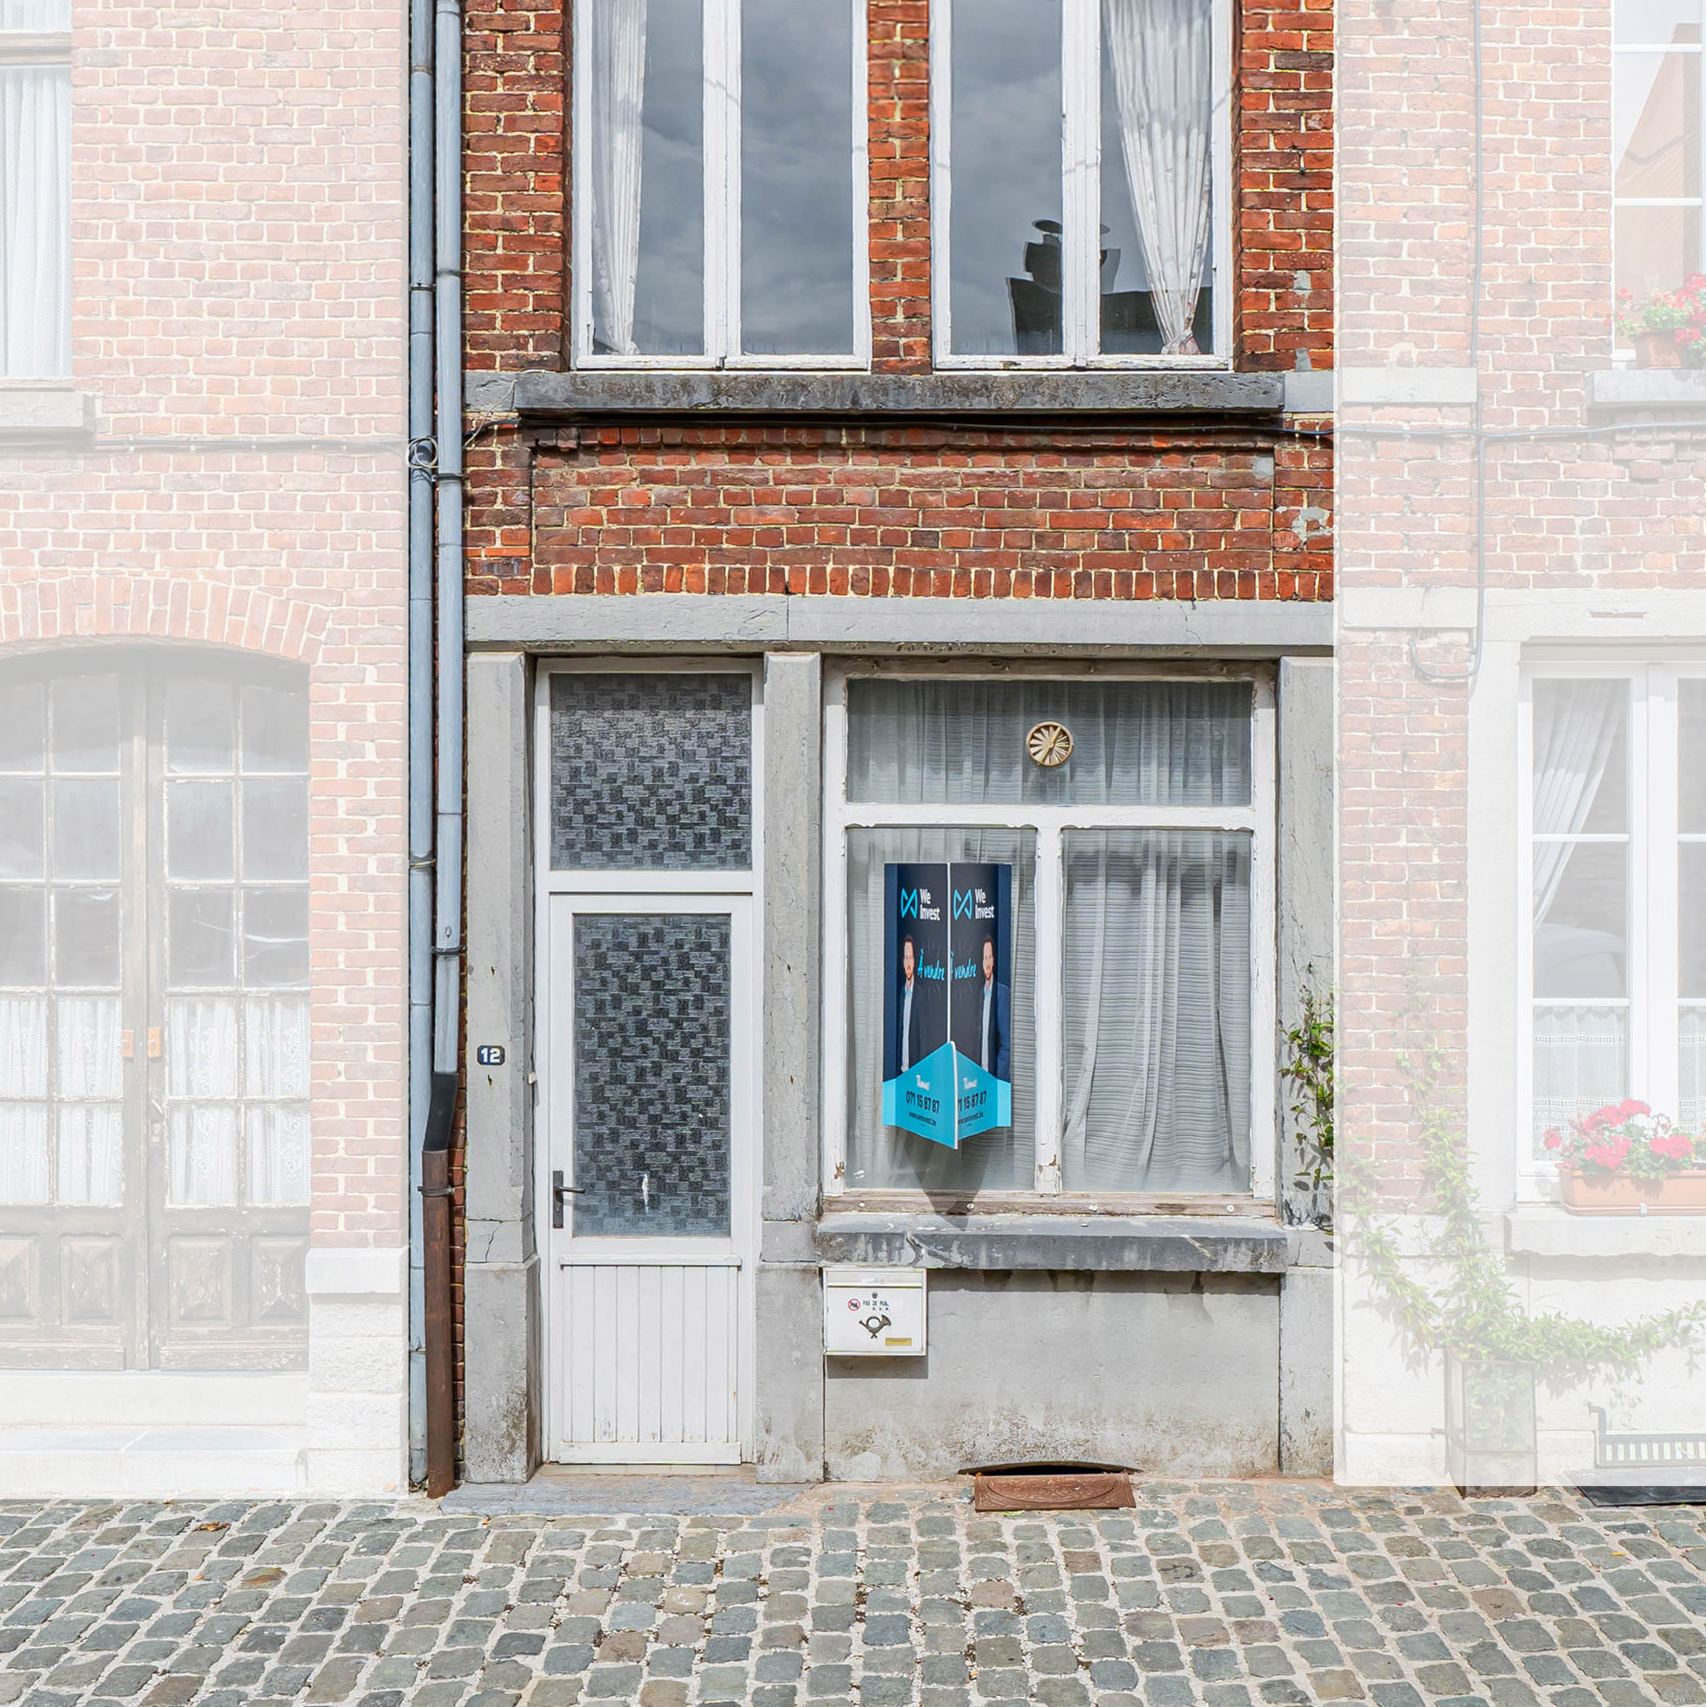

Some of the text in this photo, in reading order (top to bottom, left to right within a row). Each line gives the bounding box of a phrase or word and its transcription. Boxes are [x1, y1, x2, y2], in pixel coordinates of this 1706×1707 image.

[919, 888, 931, 904] We
[974, 888, 987, 904] We
[919, 904, 940, 921] Invest
[975, 904, 995, 919] Invest
[917, 948, 945, 981] À vendre
[954, 958, 977, 980] vendre
[480, 1047, 501, 1063] 12
[905, 1091, 940, 1114] 071 15 87 87
[963, 1095, 970, 1110] 15
[971, 1093, 979, 1108] 87
[979, 1090, 987, 1105] 87
